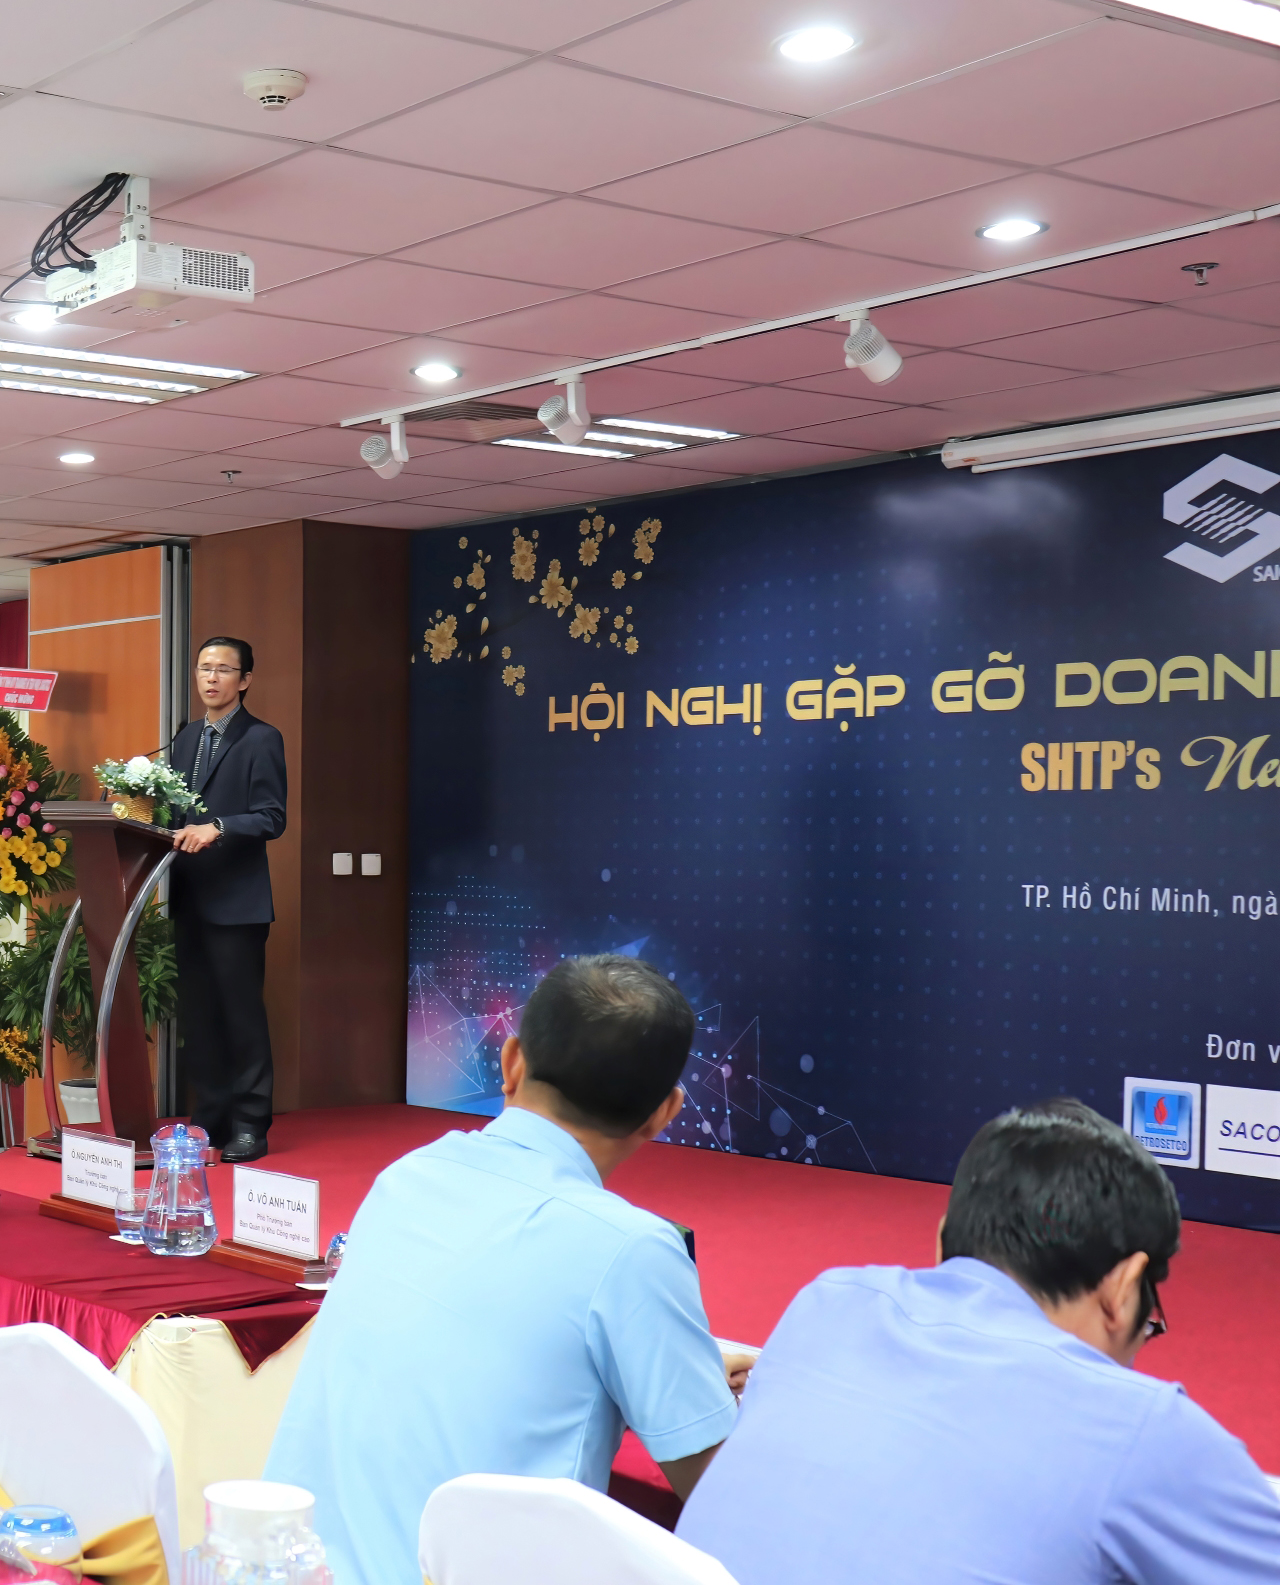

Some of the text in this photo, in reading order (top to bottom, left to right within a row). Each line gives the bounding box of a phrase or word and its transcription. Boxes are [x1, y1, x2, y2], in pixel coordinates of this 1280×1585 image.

[1253, 565, 1280, 582] SAI
[549, 649, 1280, 742] HỘI NGHỊ GẶP GỠ DOAN
[1021, 734, 1280, 792] SHTP's Ne
[1021, 884, 1051, 908] TP.
[1062, 882, 1092, 910] Hồ
[1103, 886, 1141, 911] Chí
[1151, 887, 1219, 917] Minh,
[1206, 1033, 1256, 1062] Đơn
[100, 1156, 112, 1167] ANH
[257, 1192, 268, 1205] VÕ
[269, 1196, 285, 1209] ANH
